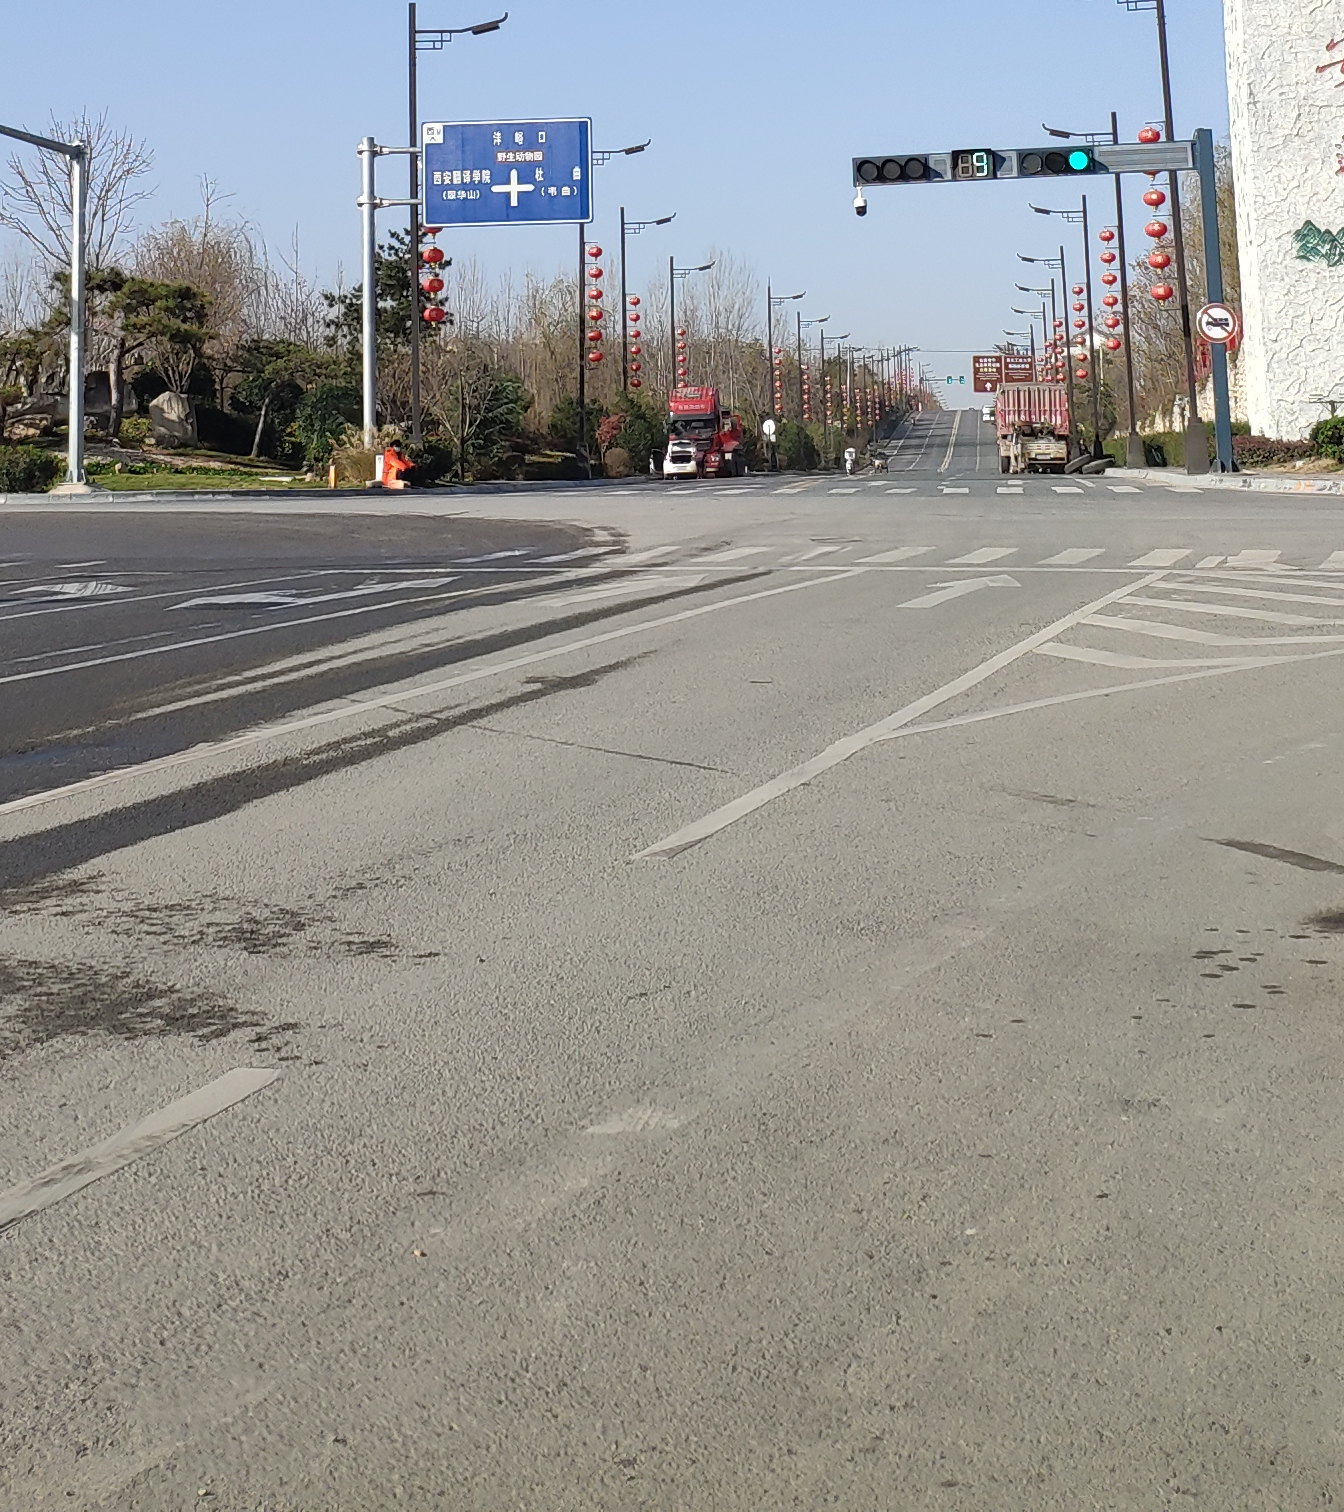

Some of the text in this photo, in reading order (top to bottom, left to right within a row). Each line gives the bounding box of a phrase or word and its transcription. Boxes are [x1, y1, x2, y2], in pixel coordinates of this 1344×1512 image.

[497, 151, 543, 162] 野生动物园
[973, 152, 988, 176] 9
